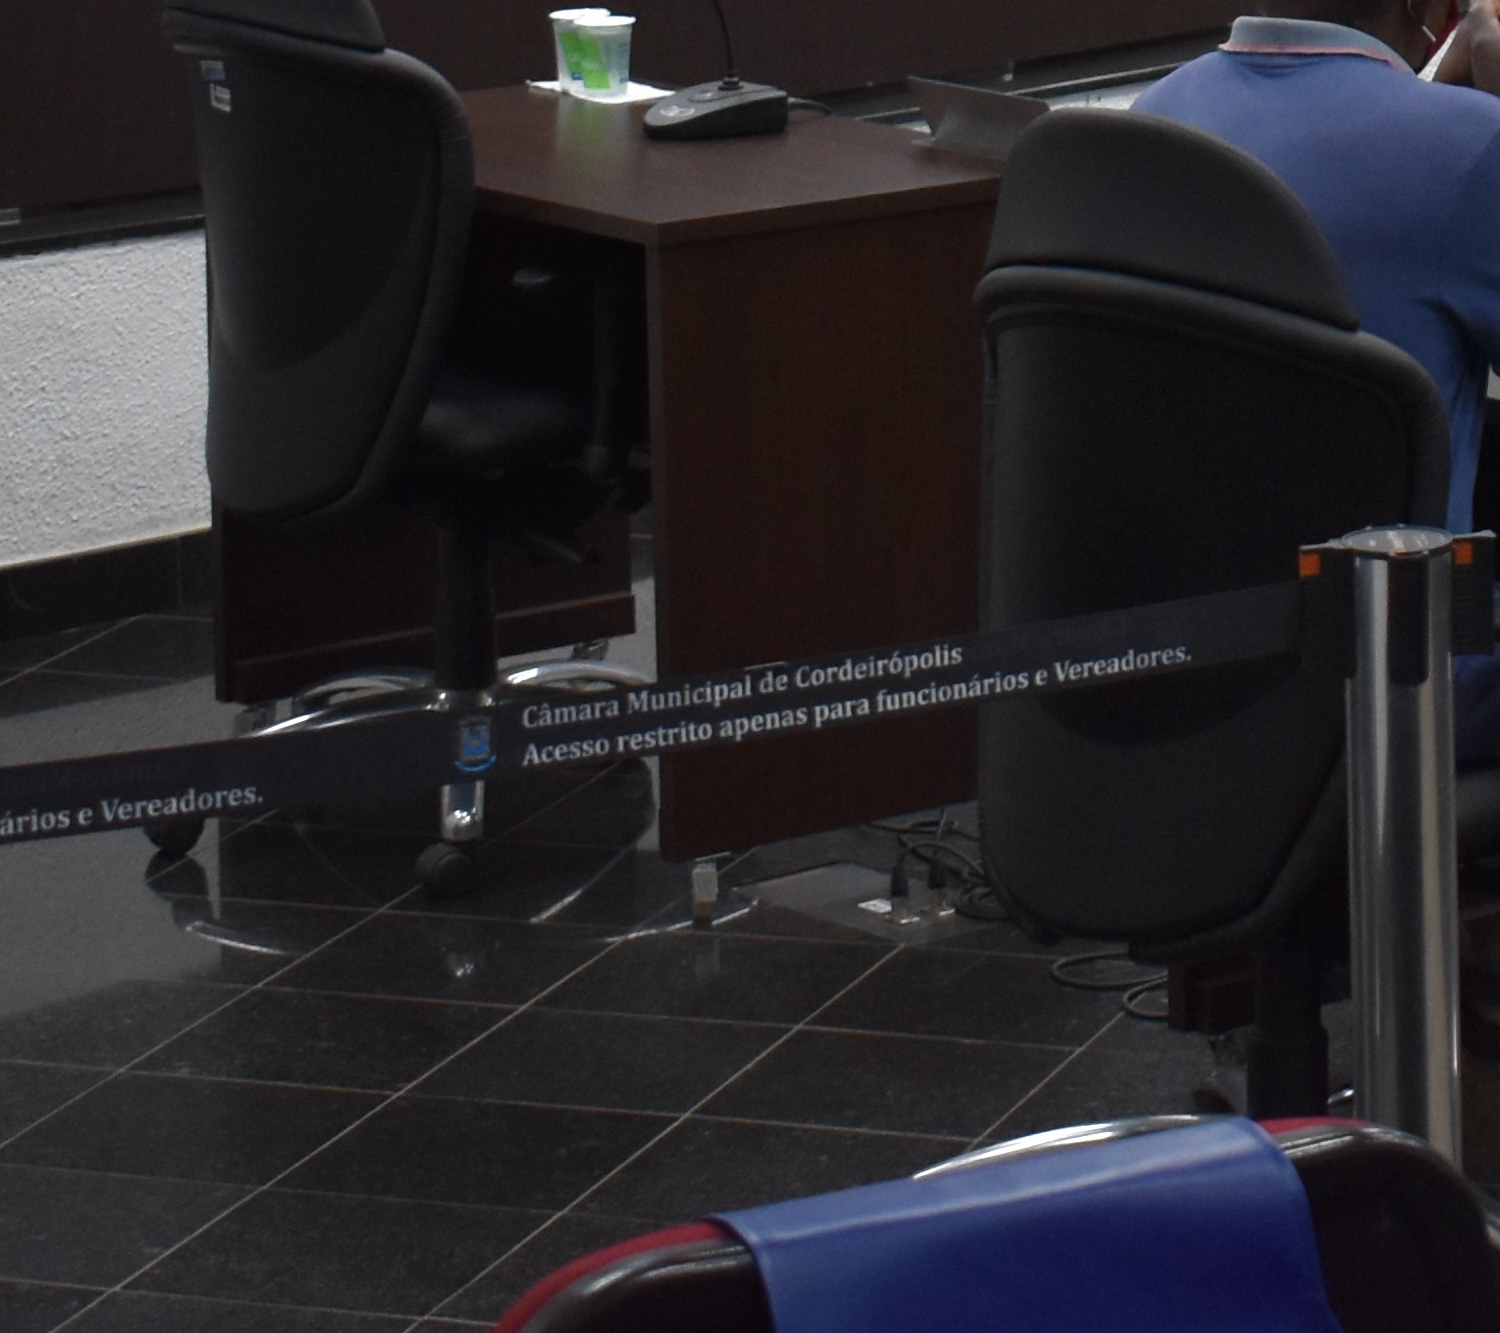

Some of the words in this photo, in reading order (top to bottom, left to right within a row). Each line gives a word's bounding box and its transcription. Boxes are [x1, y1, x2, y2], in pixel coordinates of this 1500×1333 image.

[522, 738, 610, 767] Acesso
[617, 714, 713, 753] restrito
[719, 707, 808, 745] apenas
[814, 697, 870, 727] para
[876, 669, 1029, 713] funcionários
[1035, 667, 1048, 686] e
[1054, 644, 1193, 684] Vereadores.
[523, 701, 619, 729] Câmara
[626, 674, 752, 716] Municipal
[759, 666, 789, 694] de
[796, 644, 963, 687] Cordeirópolis
[77, 806, 93, 825] e
[101, 784, 263, 823] Vereadores.
